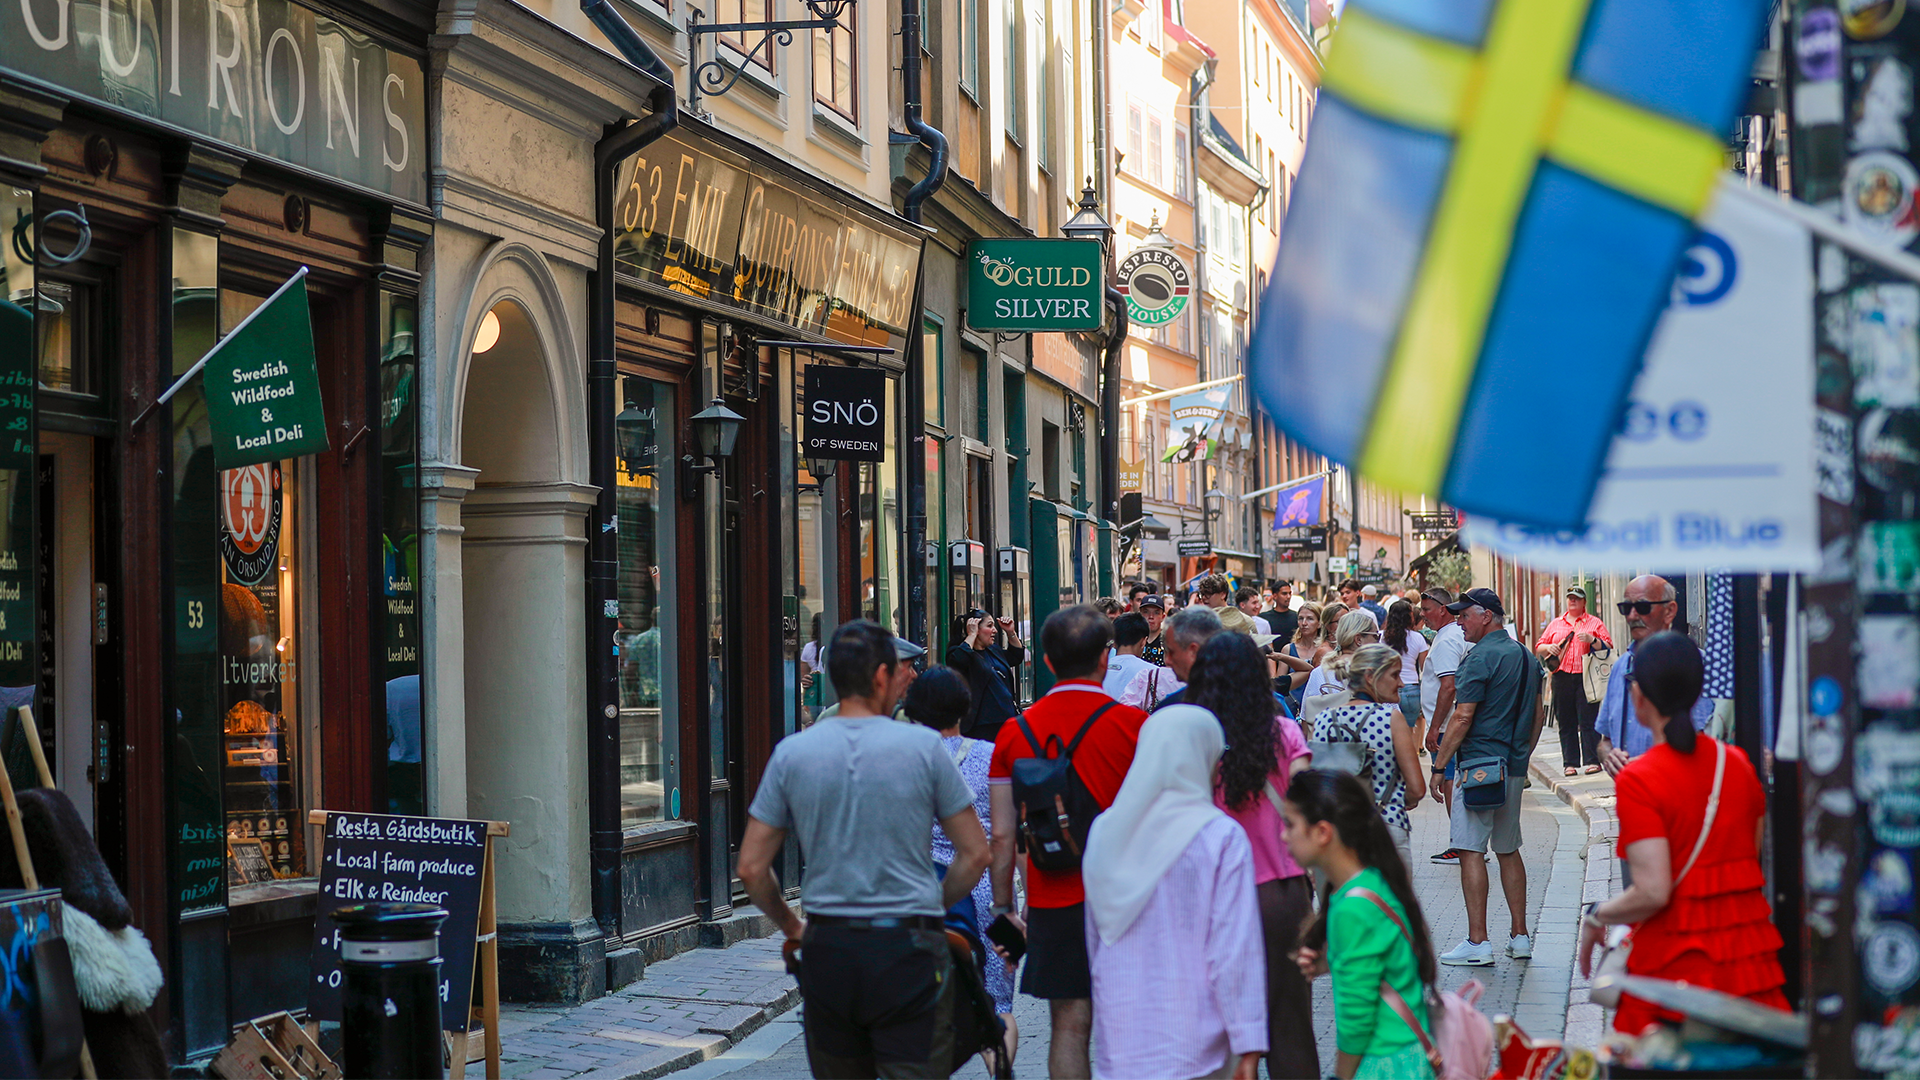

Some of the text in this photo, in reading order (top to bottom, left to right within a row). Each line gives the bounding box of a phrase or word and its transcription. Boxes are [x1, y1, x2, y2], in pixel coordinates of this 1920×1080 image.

[624, 157, 663, 239] 53
[664, 154, 727, 275] EMIL
[739, 185, 833, 303] GUIRONS
[885, 265, 910, 326] 53
[1014, 266, 1091, 287] GULD
[1118, 251, 1186, 281] ESPRESSO
[995, 298, 1092, 319] SILVER
[1126, 303, 1179, 322] HOUSE
[232, 360, 288, 384] Swedish
[231, 380, 294, 406] Wildfood
[261, 407, 273, 423] &
[812, 398, 879, 426] SNÖ
[235, 424, 303, 450] Local Deli
[811, 438, 878, 452] OF SWEDEN
[1294, 550, 1312, 558] Dala
[388, 575, 412, 591] Swedish
[188, 600, 203, 628] 53
[388, 599, 414, 615] Wildfood
[398, 622, 404, 638] &
[6, 641, 22, 661] Deli
[388, 646, 416, 662] Local Deli
[336, 816, 380, 837] Resta
[336, 848, 476, 880] Local farm produce
[335, 878, 448, 904] Elk & Reindeer
